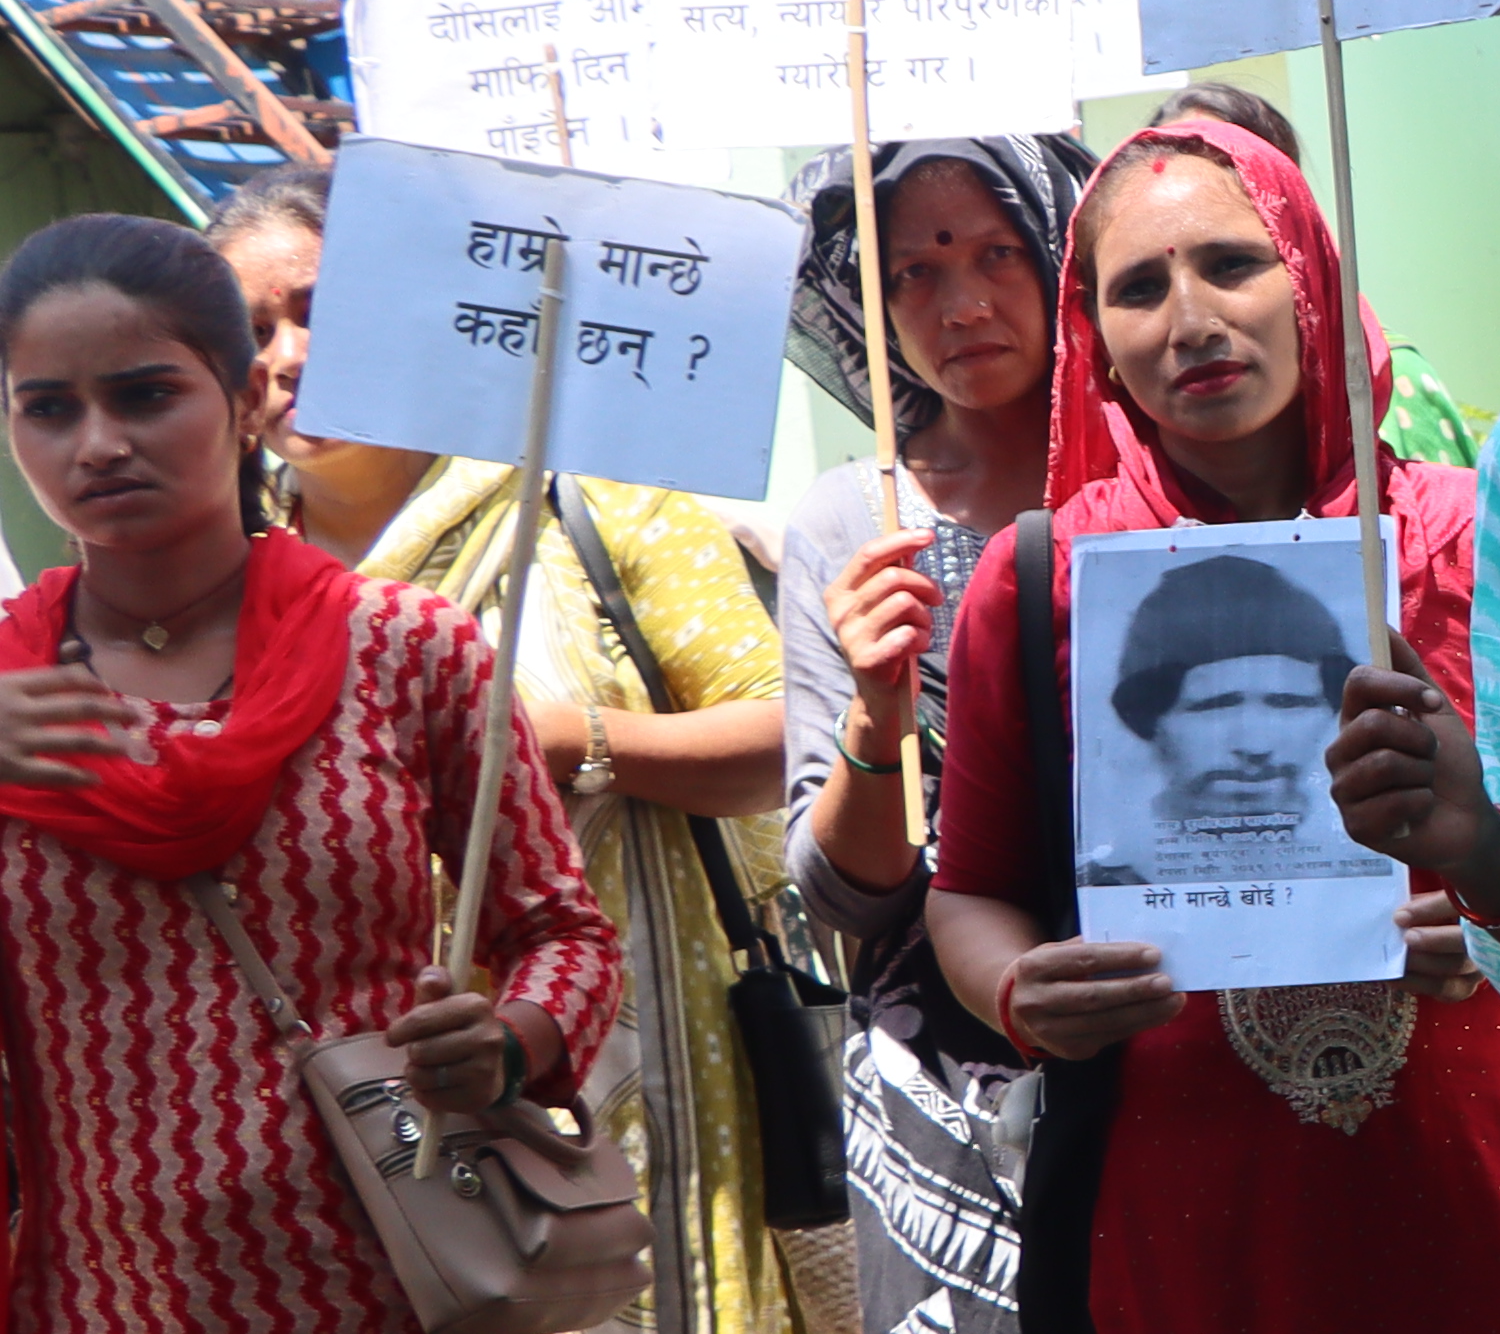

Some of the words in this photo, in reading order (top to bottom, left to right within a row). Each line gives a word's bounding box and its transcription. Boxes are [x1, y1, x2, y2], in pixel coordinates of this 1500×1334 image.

[572, 47, 630, 87] दिन
[905, 57, 949, 83] गर
[599, 237, 710, 296] मान्छे
[578, 321, 655, 388] छन्
[1143, 887, 1175, 909] मेरो
[1184, 885, 1232, 909] मान्छे
[1240, 882, 1275, 908] खोई
